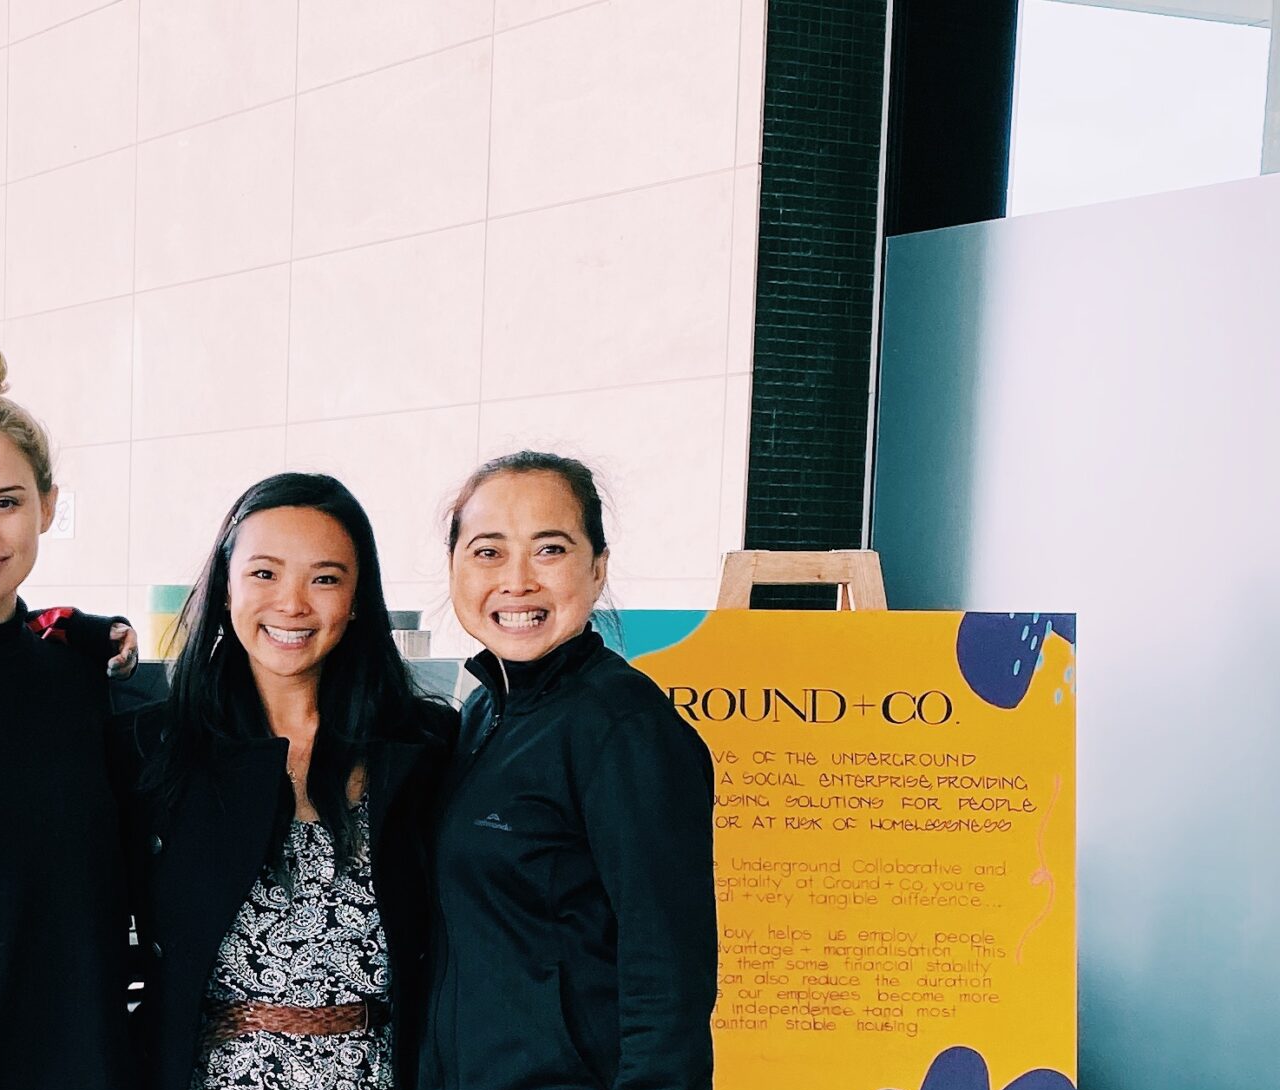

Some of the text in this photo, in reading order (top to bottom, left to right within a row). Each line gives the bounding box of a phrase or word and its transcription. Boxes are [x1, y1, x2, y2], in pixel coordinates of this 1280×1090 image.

[712, 751, 976, 767] VE OF THE UNDERGROUND
[720, 772, 733, 785] A
[743, 772, 805, 787] SOCIAL
[937, 776, 1028, 790] PROVIDING
[785, 796, 884, 809] SOLUTIONS
[902, 797, 942, 811] FOR
[959, 798, 1037, 812] PEOPLE
[752, 816, 776, 828] AT
[785, 817, 822, 830] RISK
[833, 817, 856, 830] OF
[870, 818, 1012, 832] HOMELESSNESS
[732, 857, 840, 877] Underground
[853, 858, 961, 875] Collaborative
[974, 861, 1006, 876] and
[717, 874, 782, 892] spitality
[796, 877, 814, 889] at
[823, 876, 880, 890] Ground
[933, 880, 985, 894] you're
[718, 889, 734, 902] al
[810, 891, 878, 909] tangible
[723, 925, 995, 948] buy helps us employ people
[974, 945, 1007, 958] This
[737, 957, 774, 970] them
[786, 960, 829, 971] some
[845, 957, 913, 971] financial
[926, 960, 992, 976] stability
[754, 972, 789, 985] also
[802, 973, 860, 986] reduce
[875, 973, 900, 987] the
[917, 974, 992, 988] duration
[738, 988, 763, 999] our
[776, 987, 861, 1004] employees
[877, 989, 944, 1002] become
[959, 992, 1000, 1003] more
[732, 1001, 855, 1018] independence
[917, 1005, 957, 1018] most
[713, 1017, 768, 1031] aintain
[785, 1017, 837, 1031] stable
